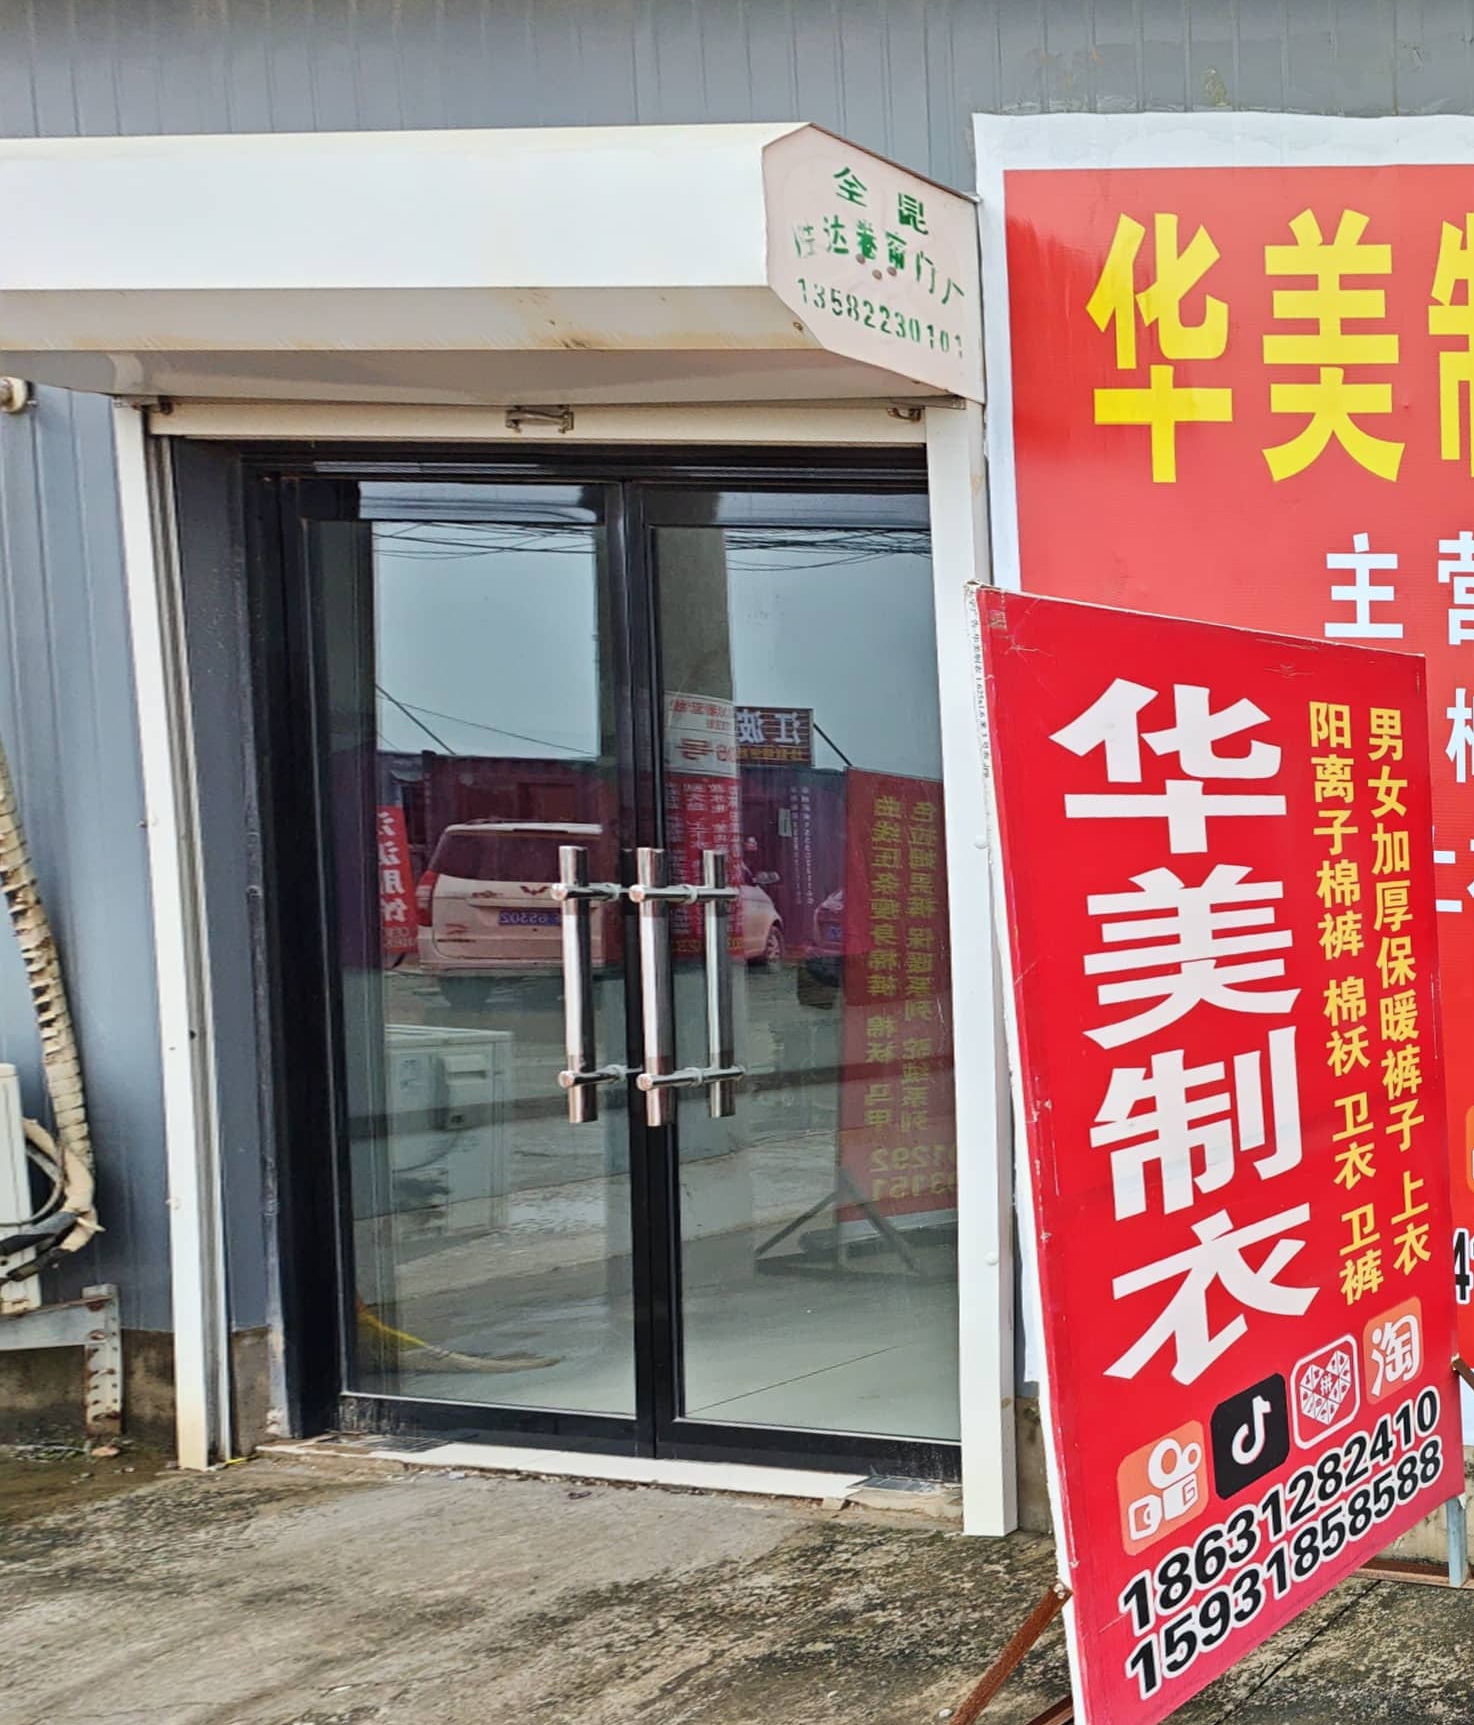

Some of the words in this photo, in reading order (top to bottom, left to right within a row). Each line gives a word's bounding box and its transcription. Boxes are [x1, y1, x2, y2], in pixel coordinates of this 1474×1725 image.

[1309, 701, 1364, 961] 阳离子棉裤
[1367, 707, 1424, 1152] 男女加厚保暖裤子
[1050, 679, 1317, 1386] 华美制衣
[1323, 976, 1371, 1077] 棉袄
[1332, 1092, 1377, 1191] 卫衣
[1391, 1170, 1432, 1276] 上衣
[1339, 1203, 1384, 1306] 卫裤
[1370, 1315, 1418, 1396] 淘
[1120, 1385, 1442, 1635] 18631282410
[1127, 1435, 1444, 1698] 15931858588
